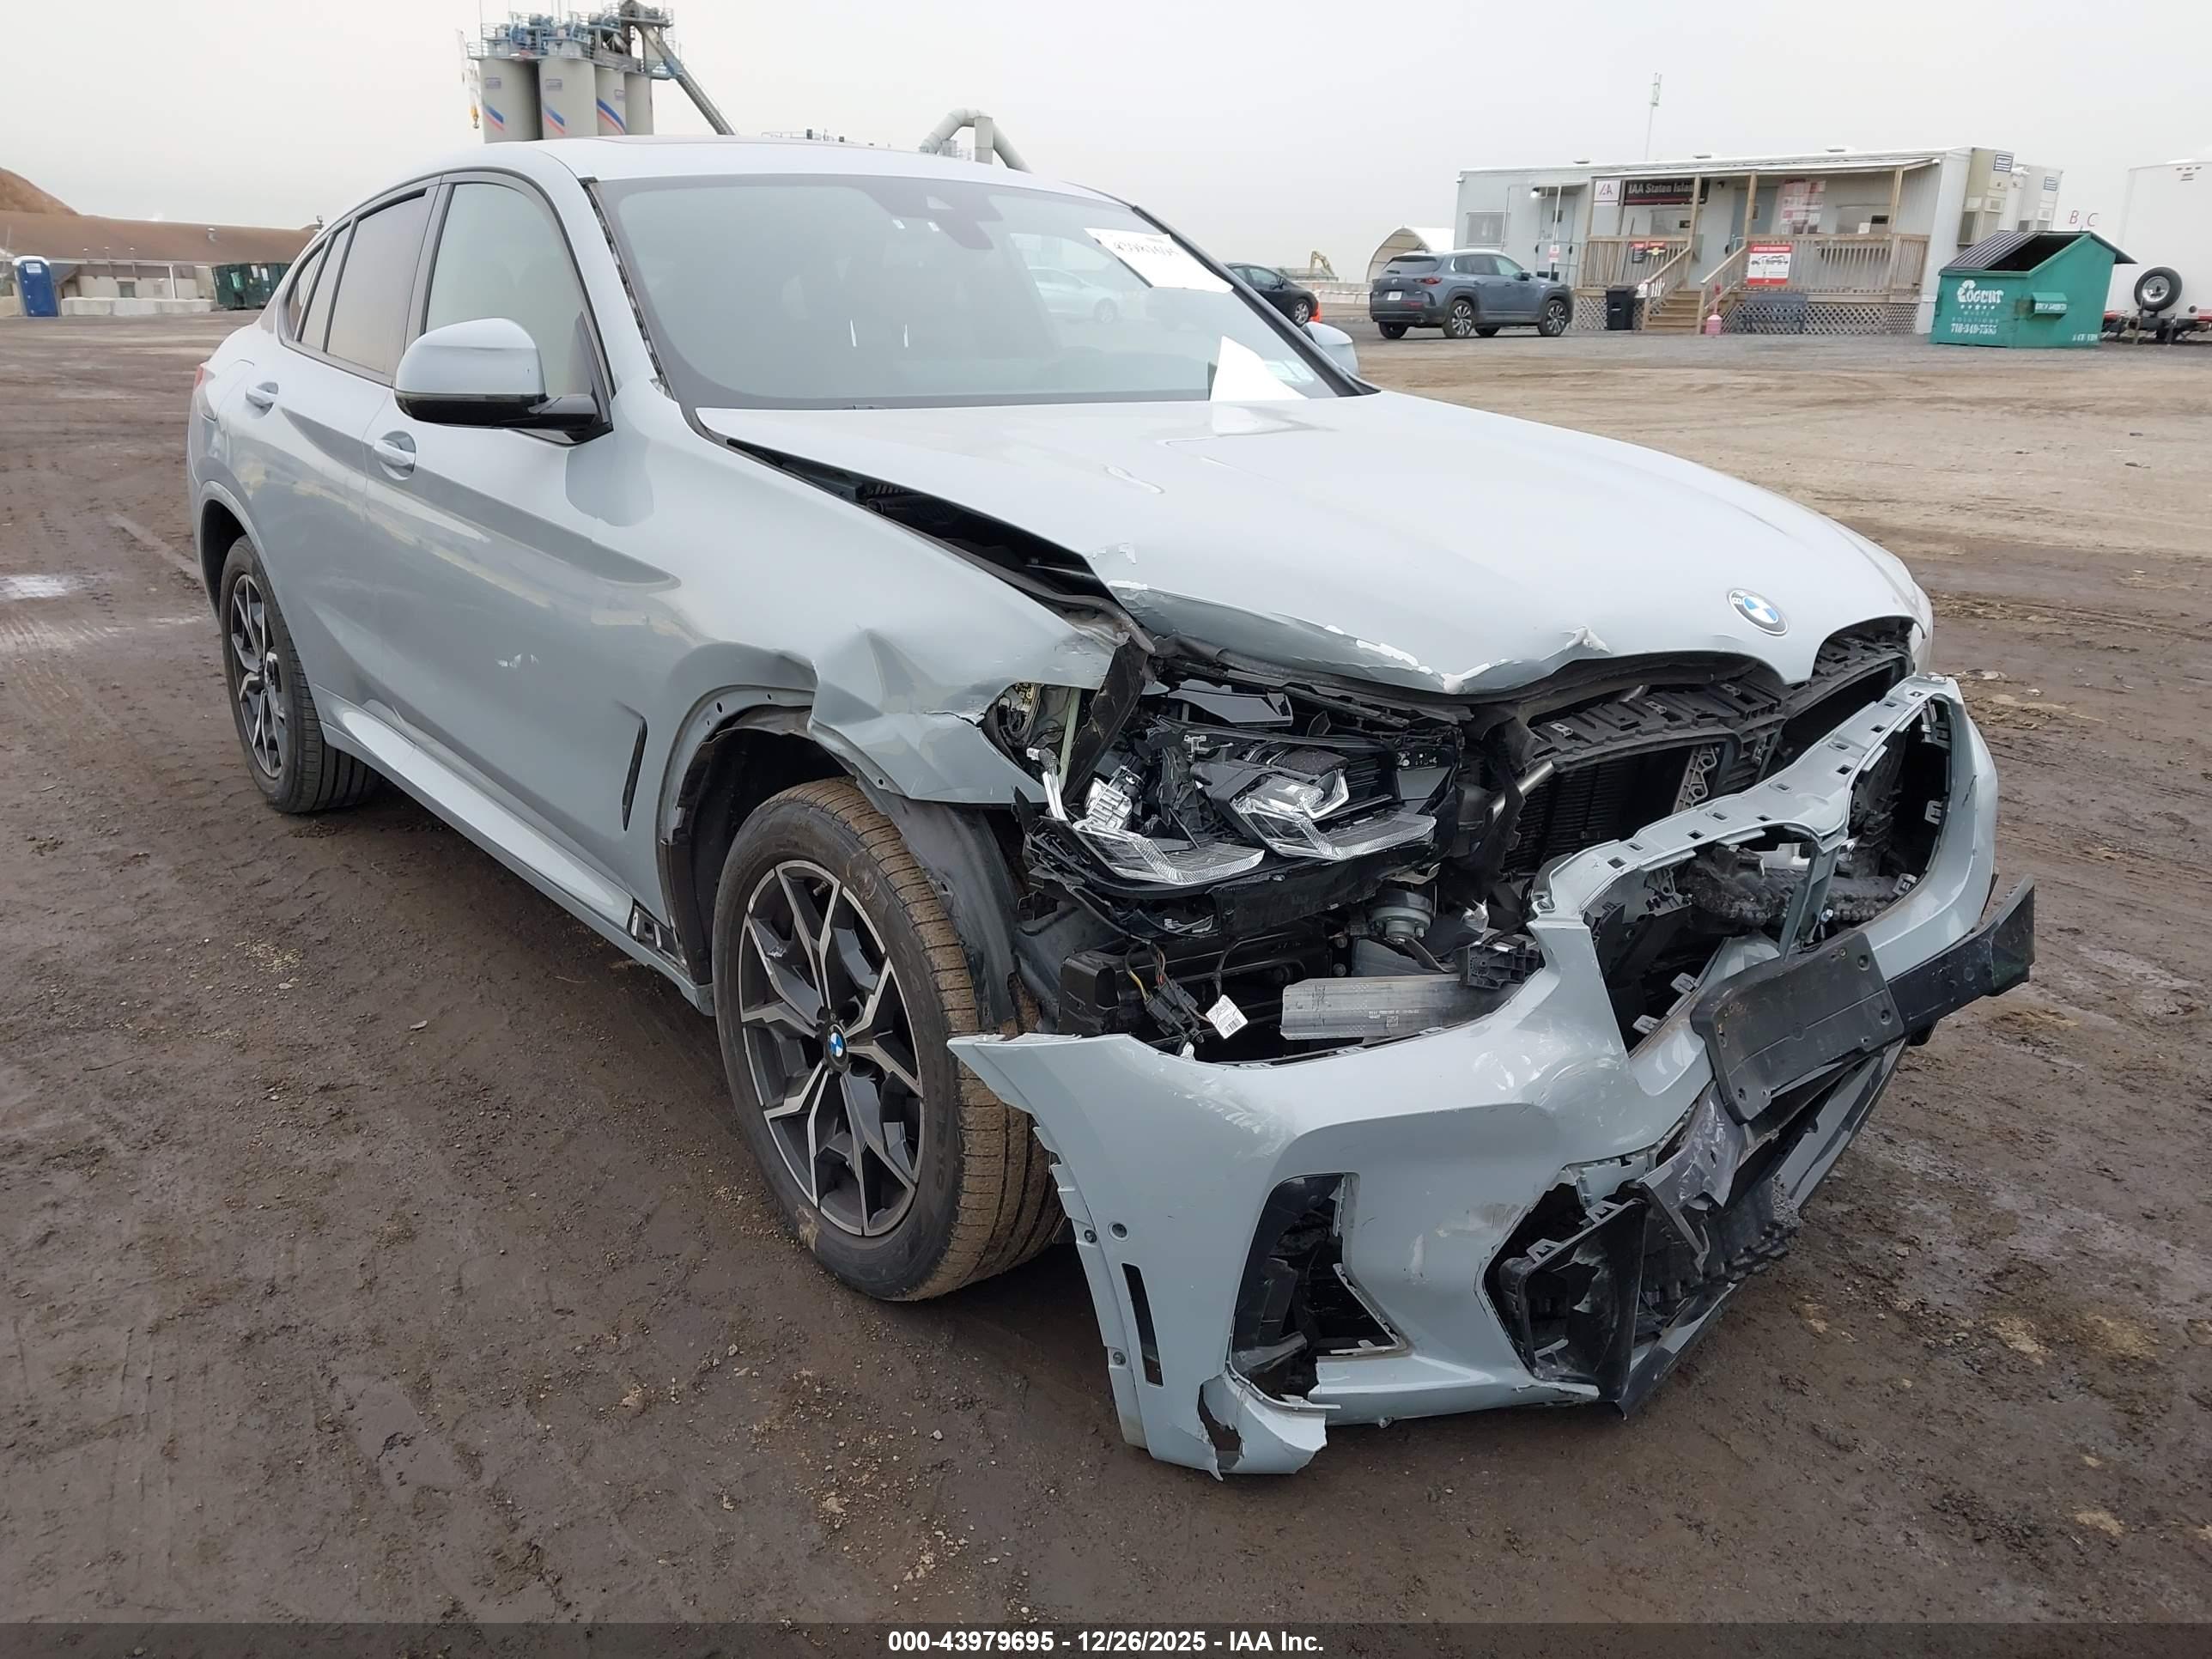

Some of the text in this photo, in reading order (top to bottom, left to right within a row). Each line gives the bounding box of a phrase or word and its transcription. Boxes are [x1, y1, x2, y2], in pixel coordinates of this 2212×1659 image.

[1628, 181, 1695, 195] IAA Staten Islan
